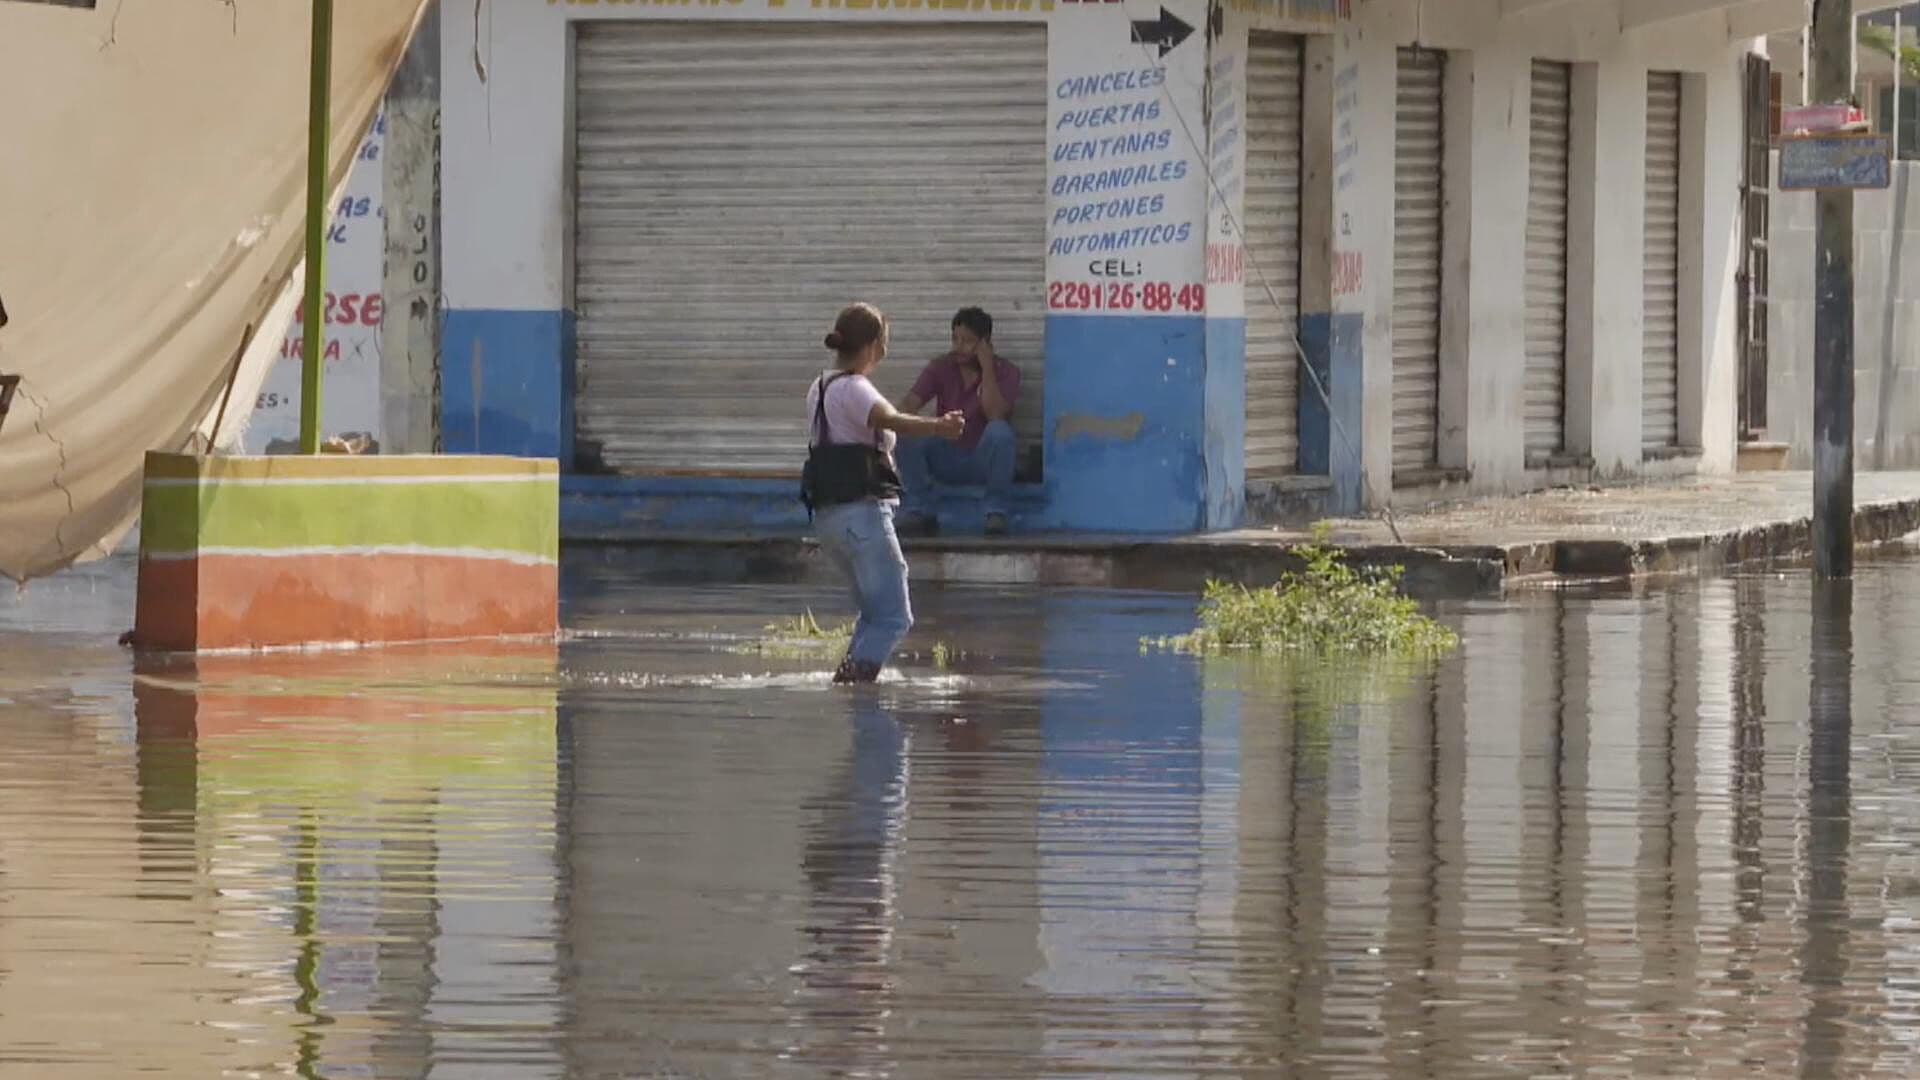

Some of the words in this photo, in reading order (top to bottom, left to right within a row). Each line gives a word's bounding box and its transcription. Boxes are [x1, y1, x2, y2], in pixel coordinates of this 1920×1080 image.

[1056, 67, 1166, 99] CANCELES
[1056, 101, 1160, 130] PUERTAS
[1053, 129, 1171, 162] VENTANAS
[1051, 160, 1187, 196] BARANDALES
[1053, 194, 1164, 225] PORTONES
[1049, 221, 1191, 256] AUTOMATICOS
[1088, 259, 1142, 277] CEL:
